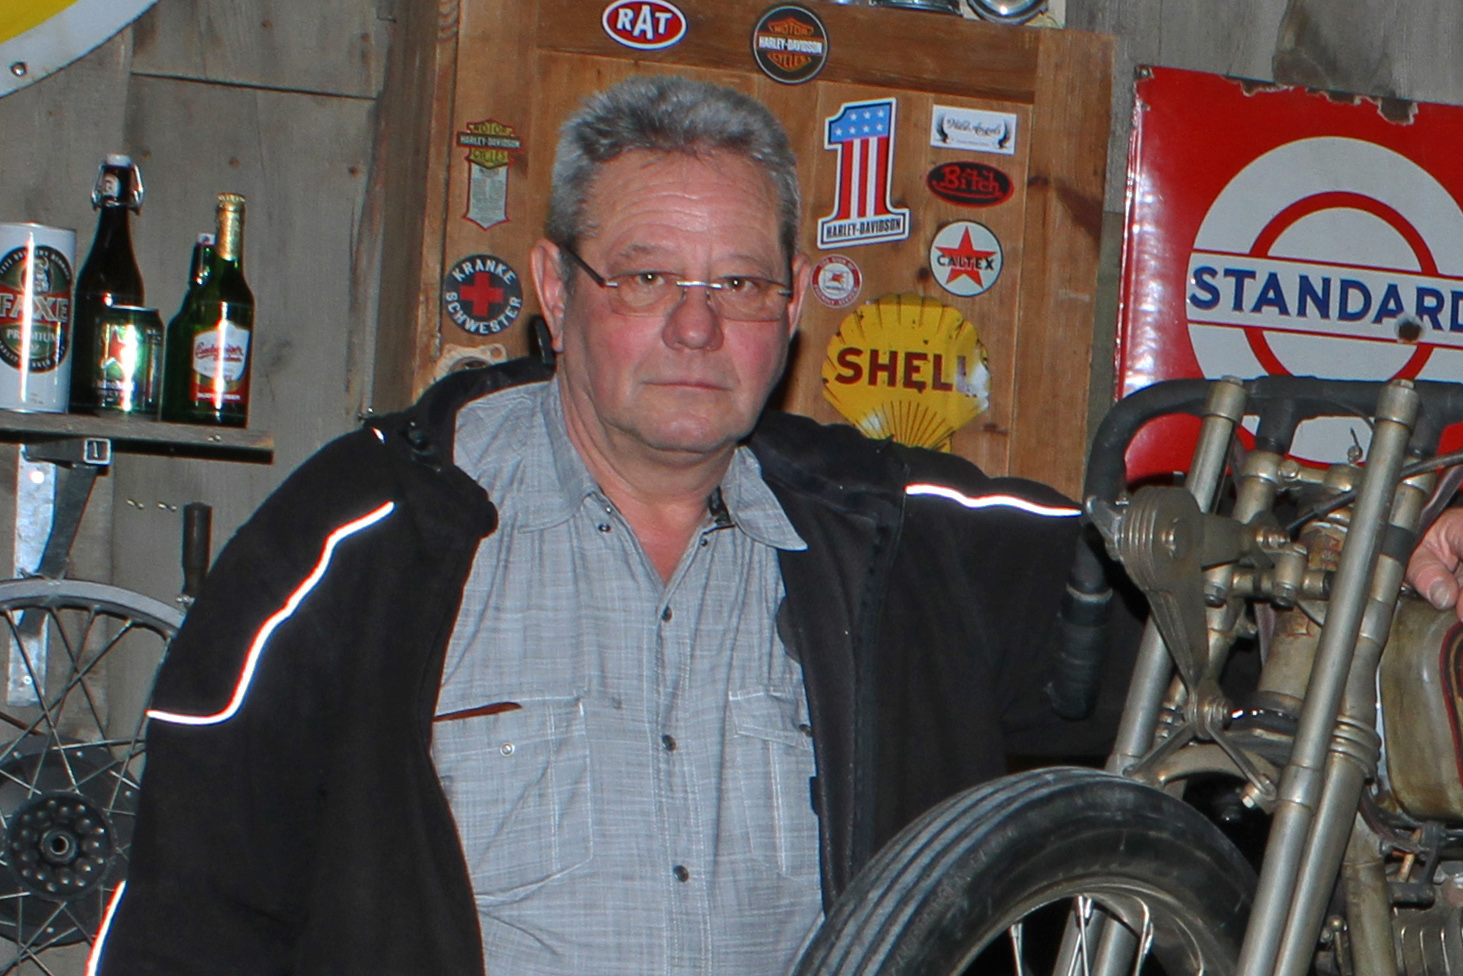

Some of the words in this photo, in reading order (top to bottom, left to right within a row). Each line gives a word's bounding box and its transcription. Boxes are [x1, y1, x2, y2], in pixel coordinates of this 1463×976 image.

[616, 4, 674, 40] RAT
[826, 216, 901, 238] HARLEY-DAVIDSON
[452, 258, 518, 286] KRANKE
[936, 254, 995, 270] CALTEX
[445, 291, 522, 335] SCHWESTER
[834, 347, 978, 397] SHELL
